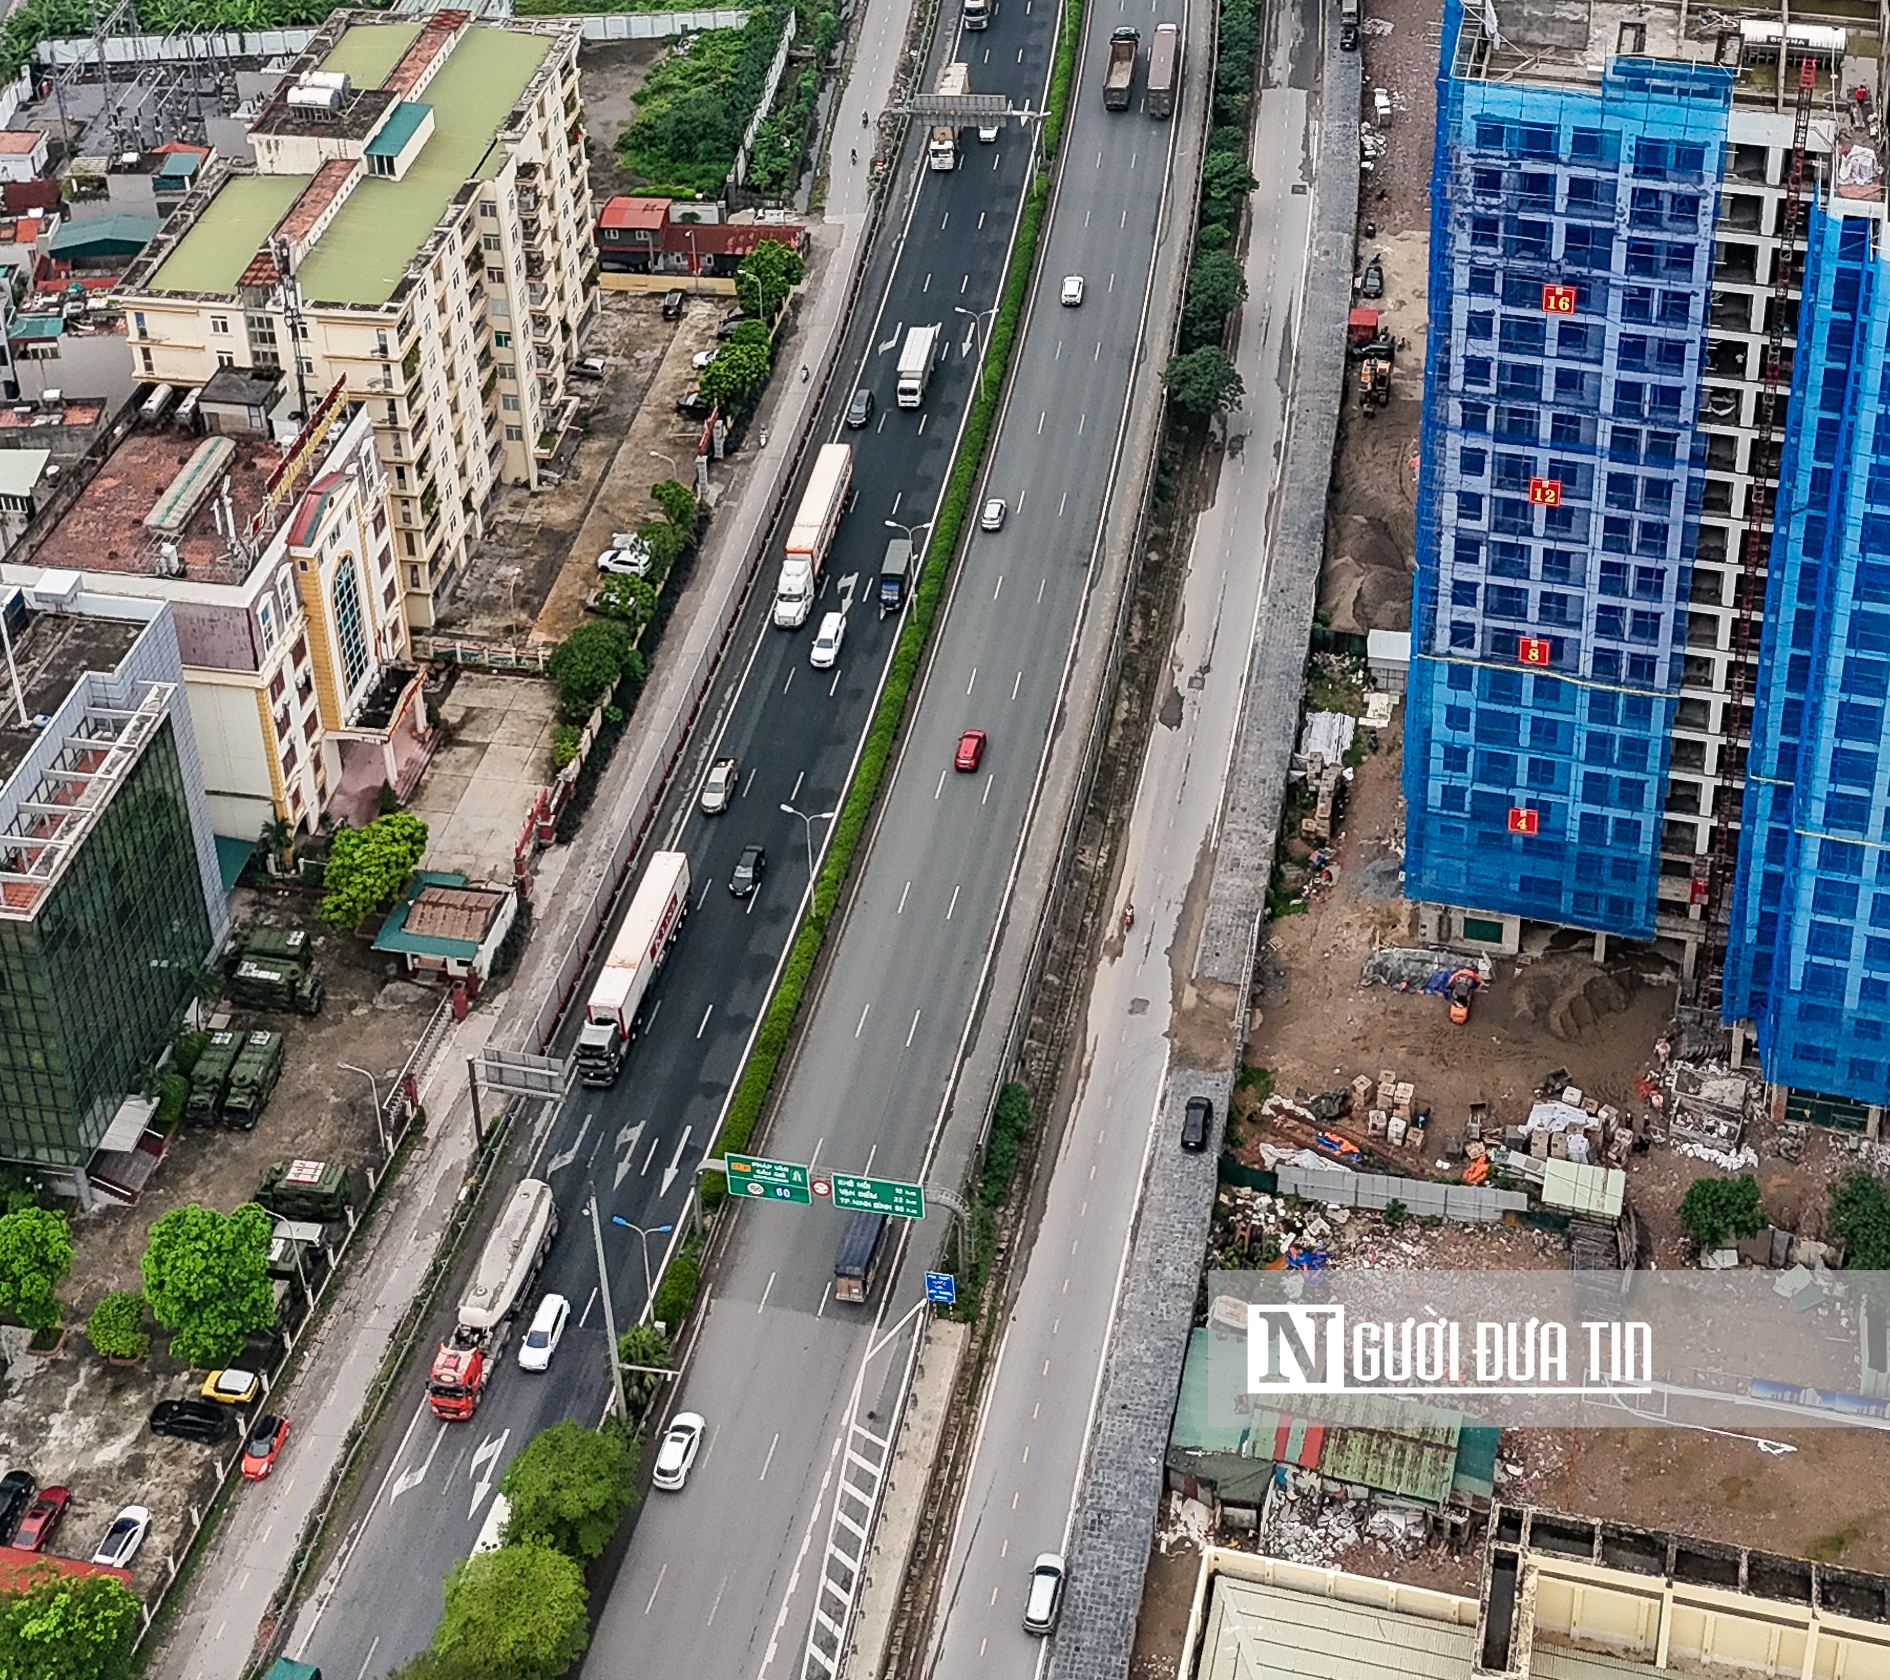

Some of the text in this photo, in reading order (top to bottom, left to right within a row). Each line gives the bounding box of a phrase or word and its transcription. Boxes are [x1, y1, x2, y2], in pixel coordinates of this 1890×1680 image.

[1547, 295, 1570, 311] 16
[1534, 488, 1556, 503] 12
[1528, 648, 1539, 661] 8
[1516, 817, 1527, 830] 4
